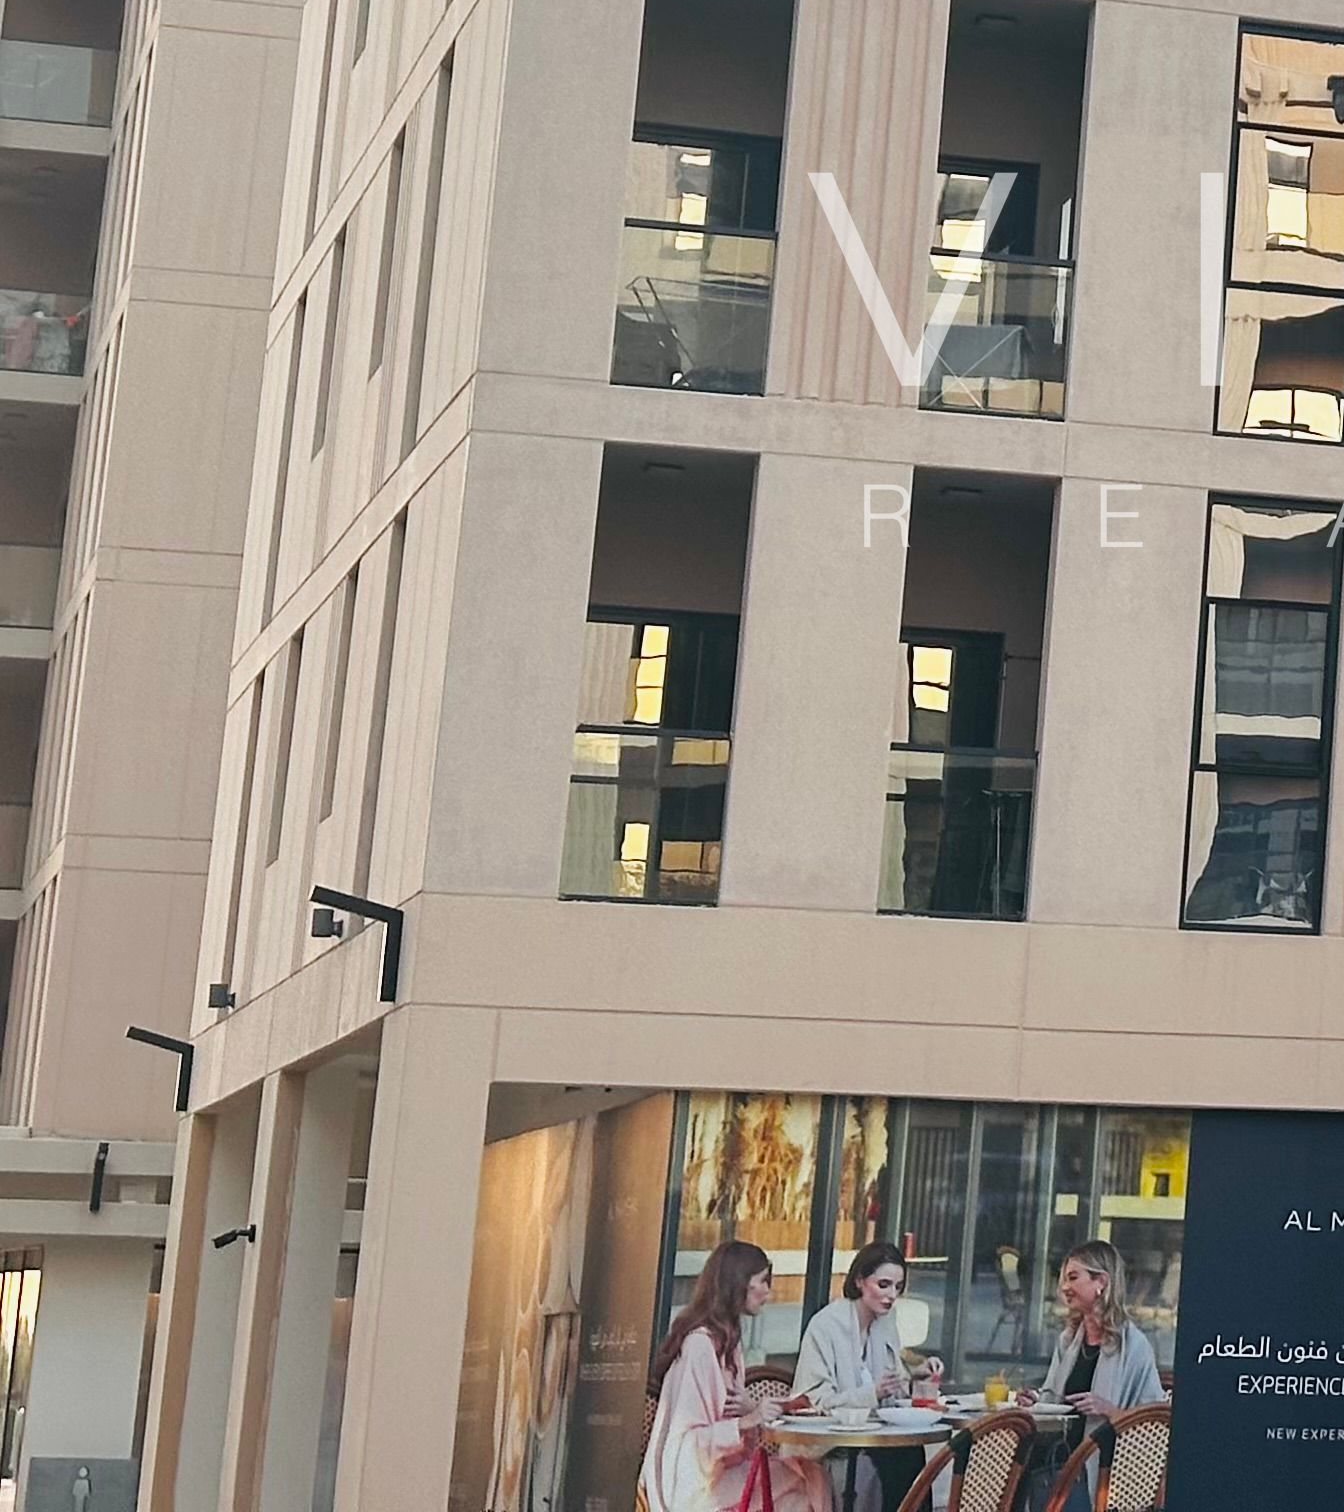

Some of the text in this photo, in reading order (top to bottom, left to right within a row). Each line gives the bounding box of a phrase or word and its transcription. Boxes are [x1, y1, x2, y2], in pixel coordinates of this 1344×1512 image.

[1284, 1210, 1321, 1231] AL
[1197, 1335, 1270, 1362] الطعام
[1277, 1340, 1328, 1363] فنون
[1266, 1427, 1297, 1441] NEW
